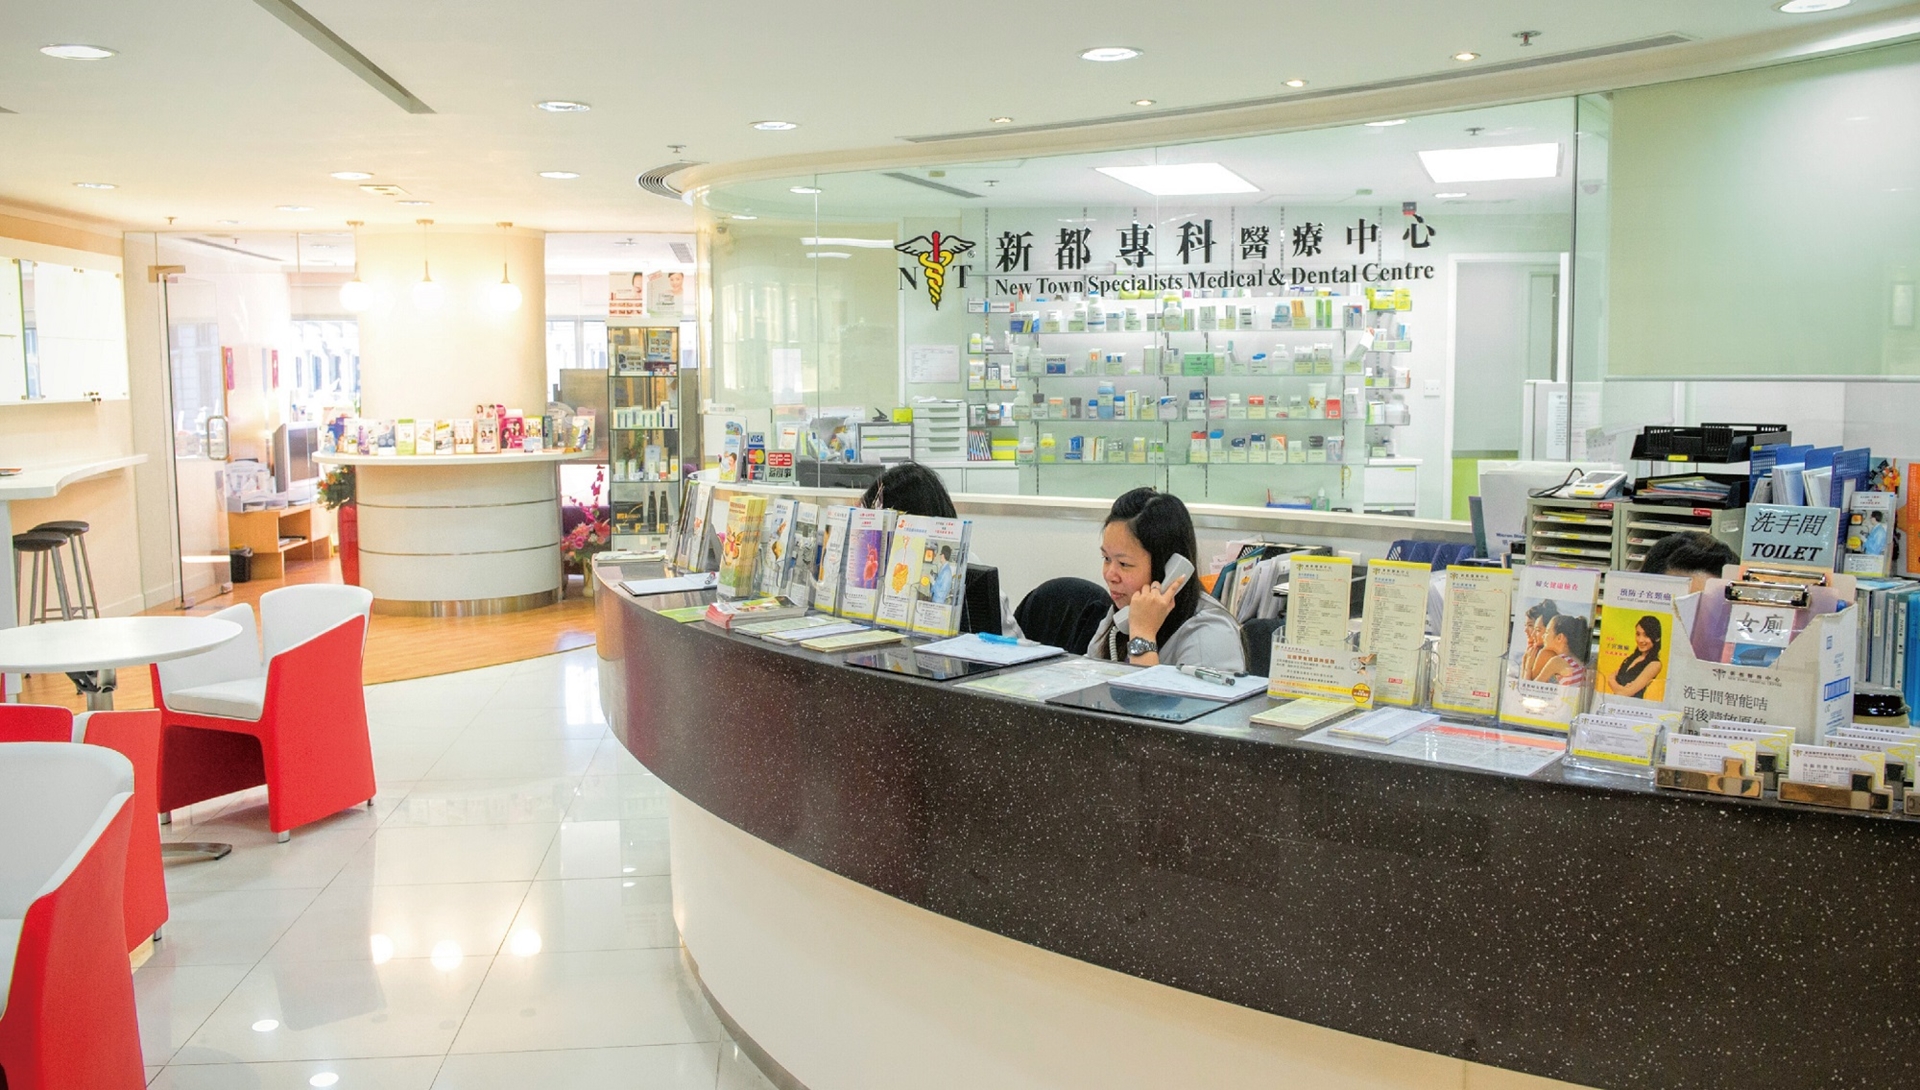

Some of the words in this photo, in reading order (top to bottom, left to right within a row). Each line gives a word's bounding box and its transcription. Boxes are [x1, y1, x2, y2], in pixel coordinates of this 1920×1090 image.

[995, 213, 1436, 273] 新都專科醫療中心
[899, 266, 918, 290] N
[952, 264, 973, 288] T
[995, 279, 1032, 296] New
[1036, 277, 1083, 294] Town
[1088, 274, 1183, 297] Specialists
[1187, 268, 1263, 289] Medical
[1268, 267, 1286, 286] &
[1291, 264, 1357, 285] Dental
[1362, 262, 1434, 282] Centre
[769, 454, 791, 465] EPS
[1750, 511, 1828, 536] 洗手間
[1750, 542, 1823, 562] TOILET
[1683, 685, 1769, 711] 洗手間智能咭
